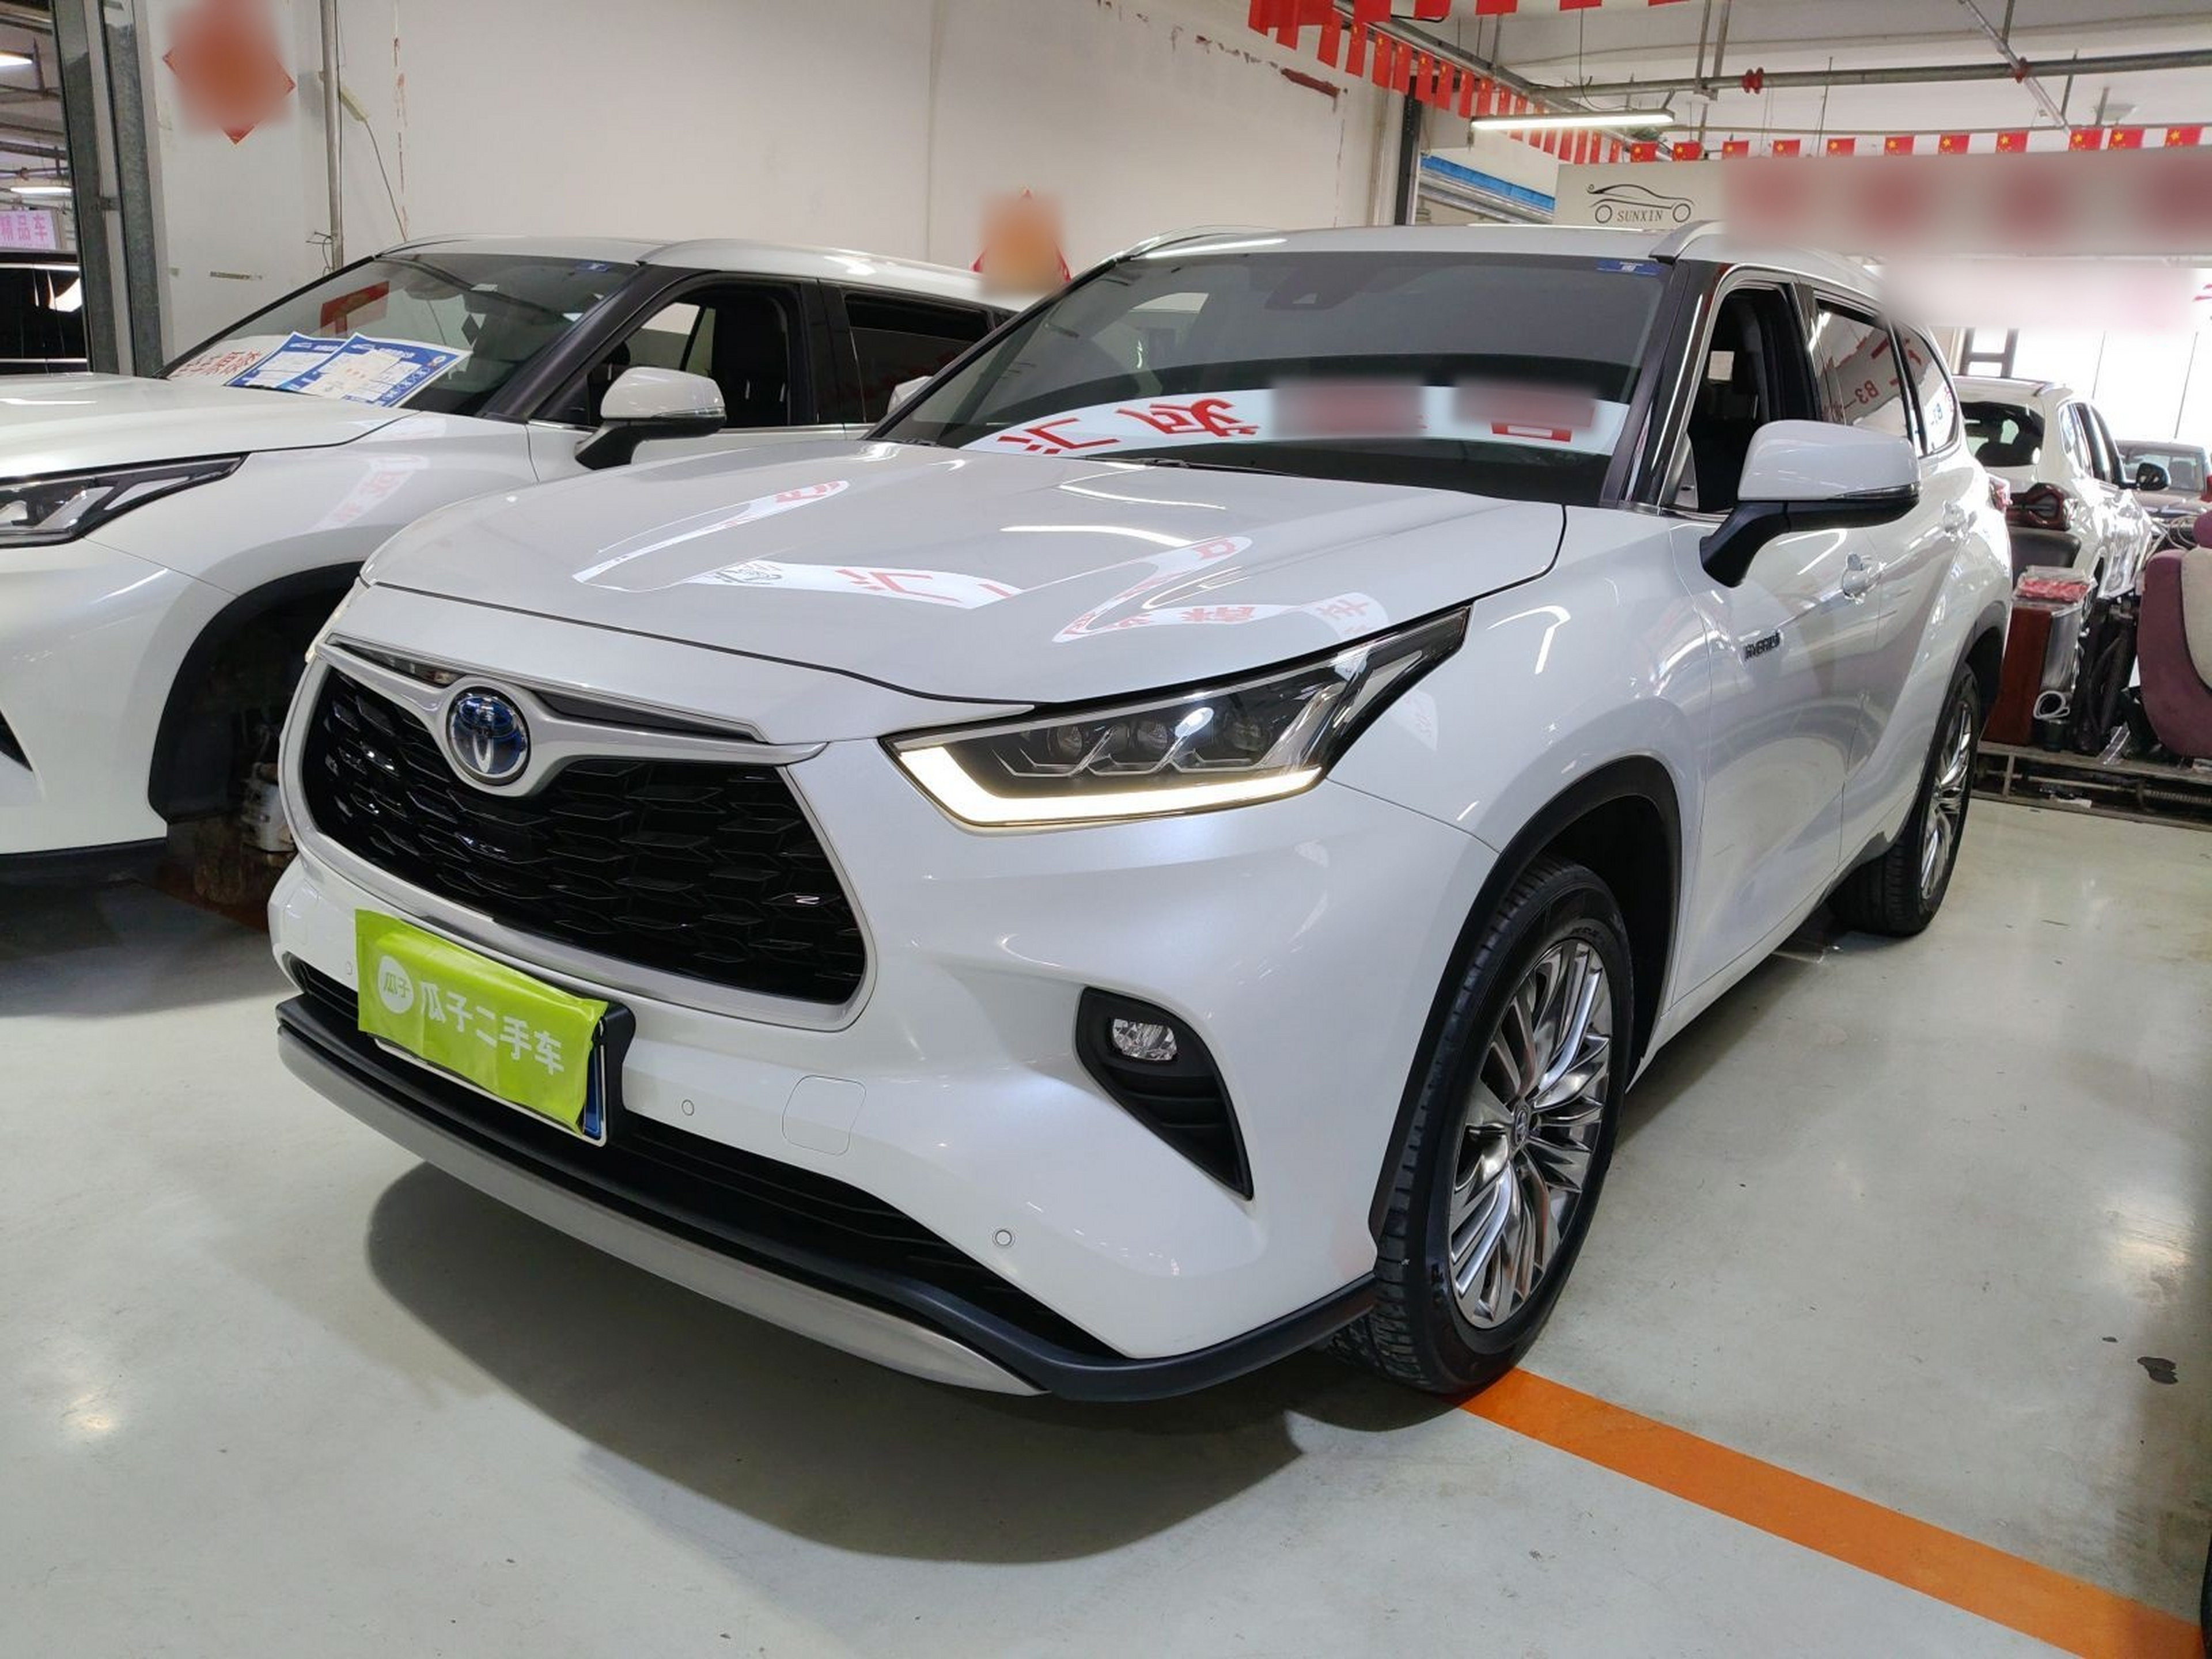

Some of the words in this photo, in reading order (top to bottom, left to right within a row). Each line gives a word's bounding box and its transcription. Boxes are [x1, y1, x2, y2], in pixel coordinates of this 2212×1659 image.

[1616, 210, 1663, 222] SUNXIN
[384, 972, 410, 998] 瓜子
[421, 981, 565, 1075] 瓜子二手车
